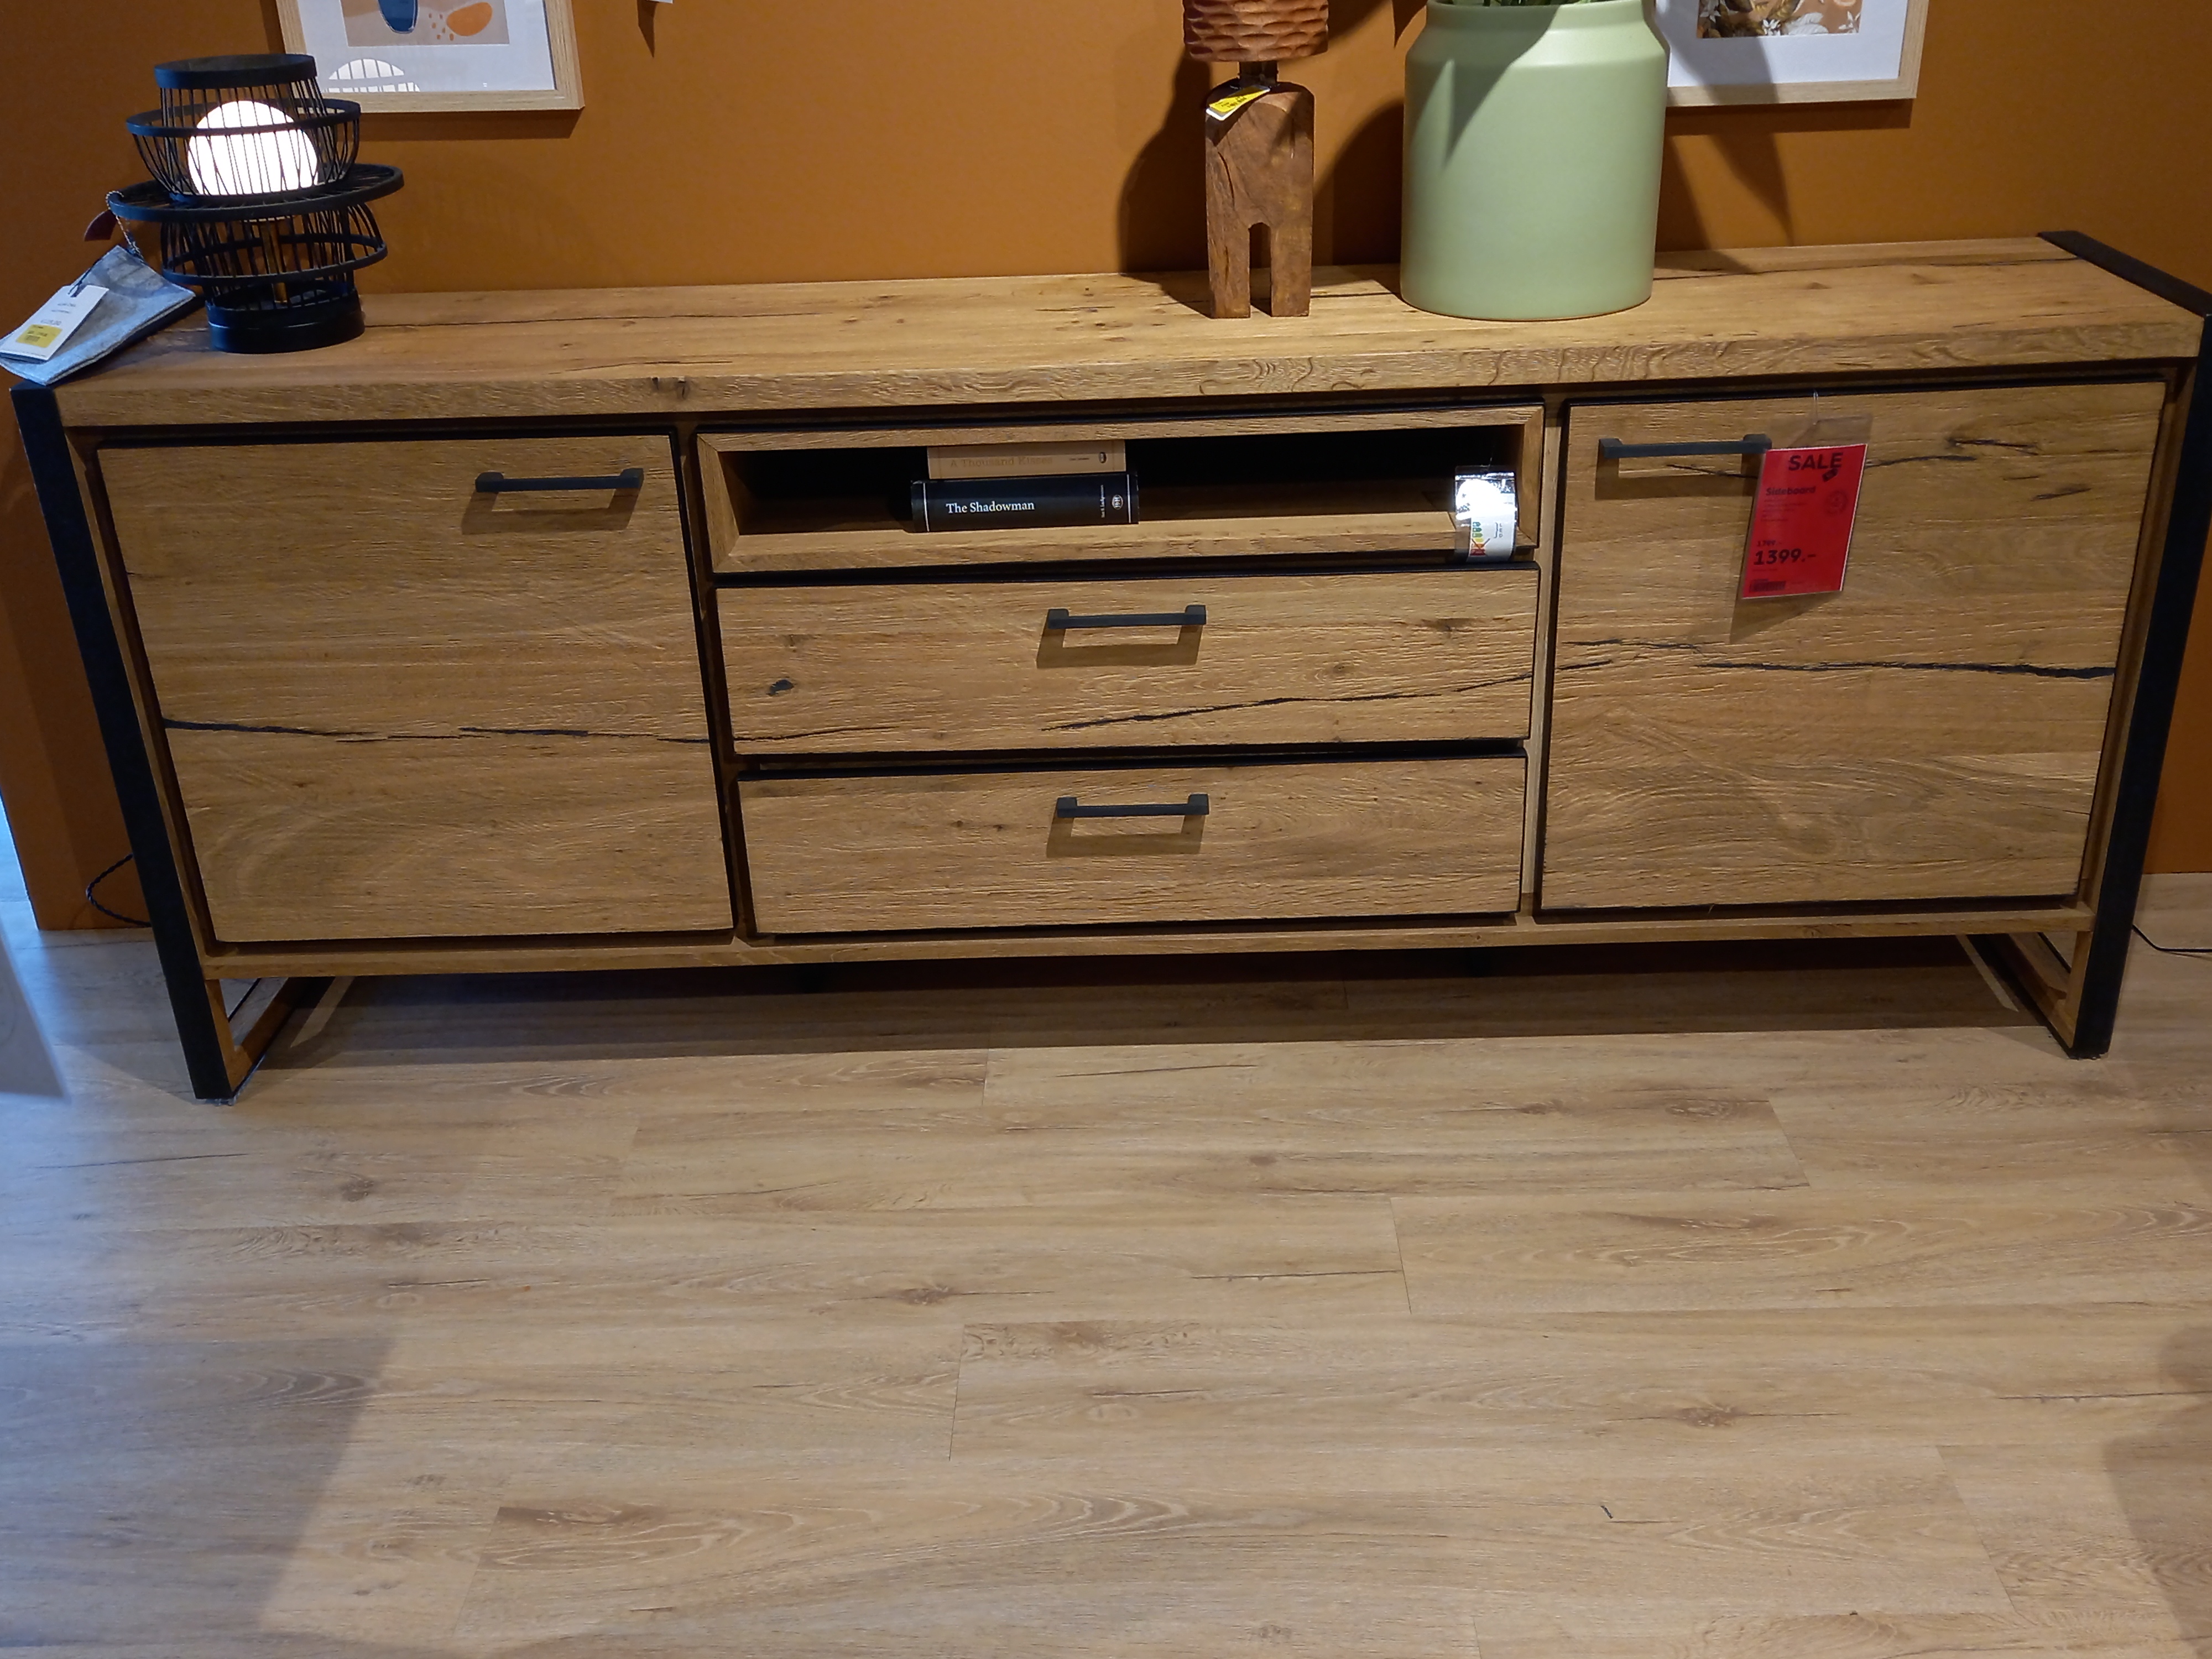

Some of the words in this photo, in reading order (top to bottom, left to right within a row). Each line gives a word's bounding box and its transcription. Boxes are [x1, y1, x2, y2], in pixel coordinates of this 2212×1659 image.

[950, 460, 958, 468] A
[962, 457, 1014, 467] Thousand
[1019, 456, 1053, 465] Kisses
[1788, 452, 1843, 471] SALE
[1765, 486, 1817, 497] Sideboard
[946, 503, 968, 514] The
[969, 500, 1036, 513] Shadowman
[1753, 548, 1817, 566] 1399.-
